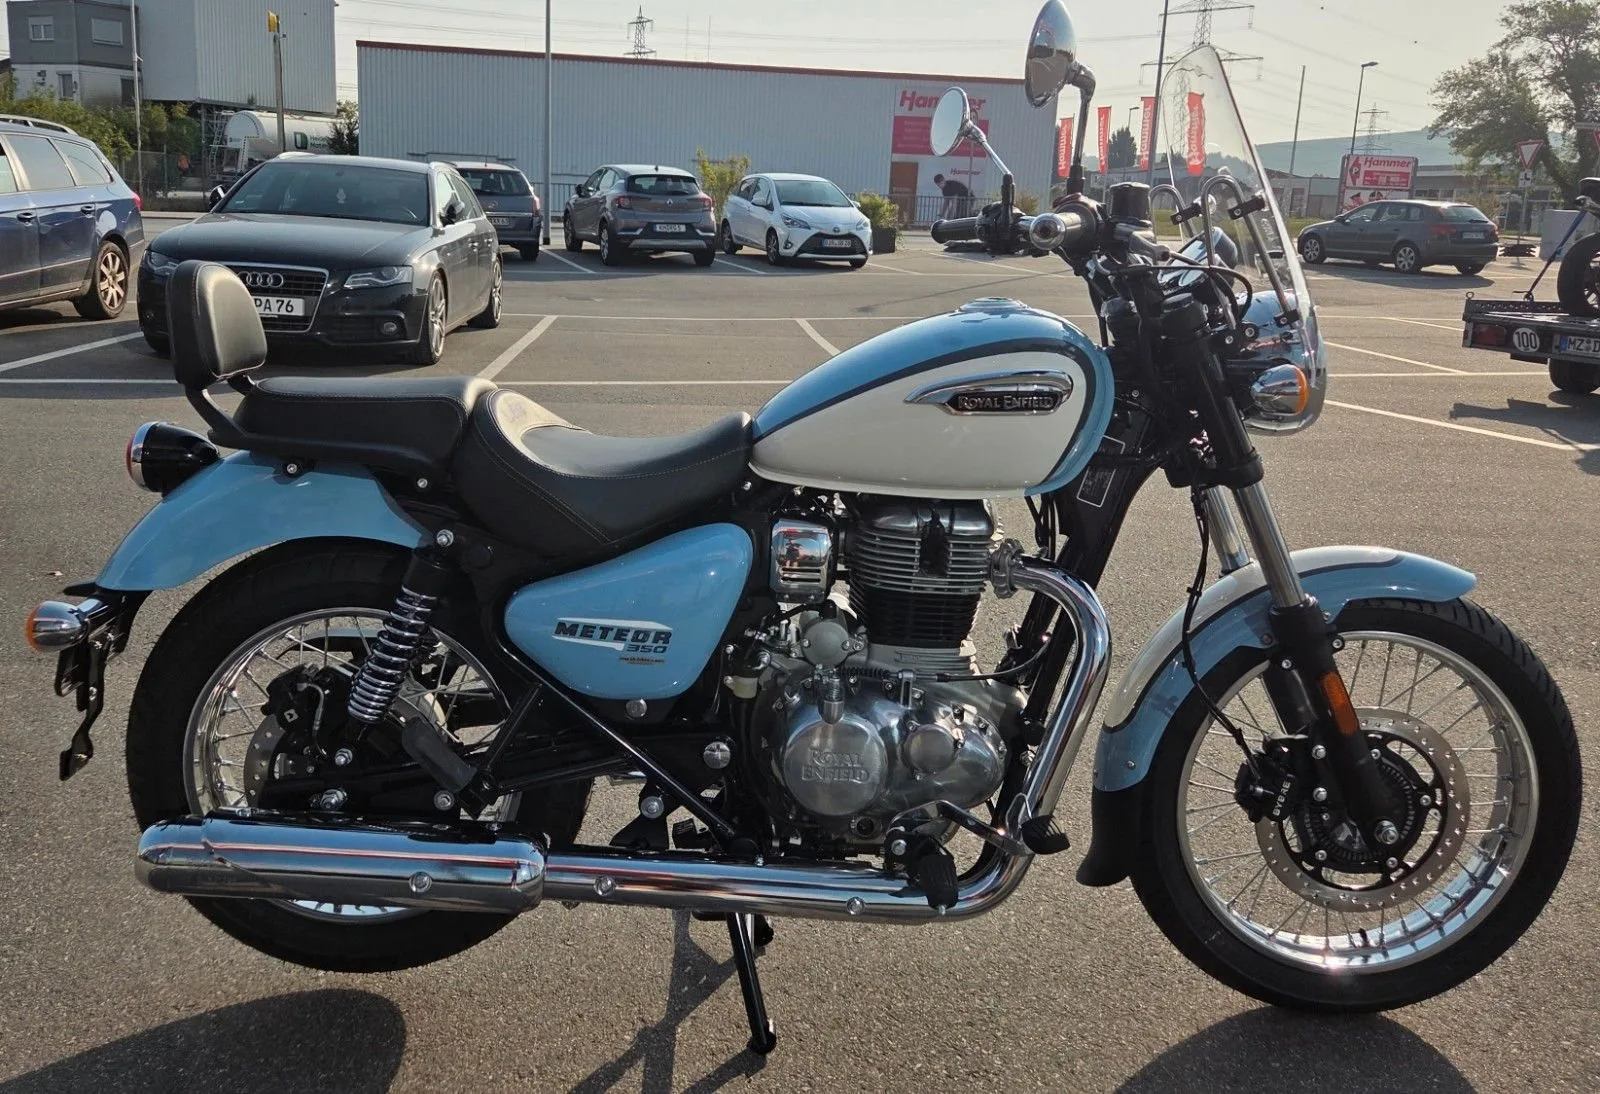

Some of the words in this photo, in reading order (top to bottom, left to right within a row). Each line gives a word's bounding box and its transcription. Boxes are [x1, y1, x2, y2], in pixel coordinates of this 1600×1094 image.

[1364, 157, 1413, 168] Hammer
[276, 299, 294, 313] 76
[1515, 331, 1538, 350] 100
[958, 396, 1000, 409] ROYAL
[1003, 395, 1054, 409] ENFIELD
[554, 621, 673, 645] METEOR
[627, 643, 668, 654] 350
[807, 746, 862, 767] ROYAL
[801, 765, 869, 784] ENFIELD
[1272, 780, 1291, 816] BYBRE
